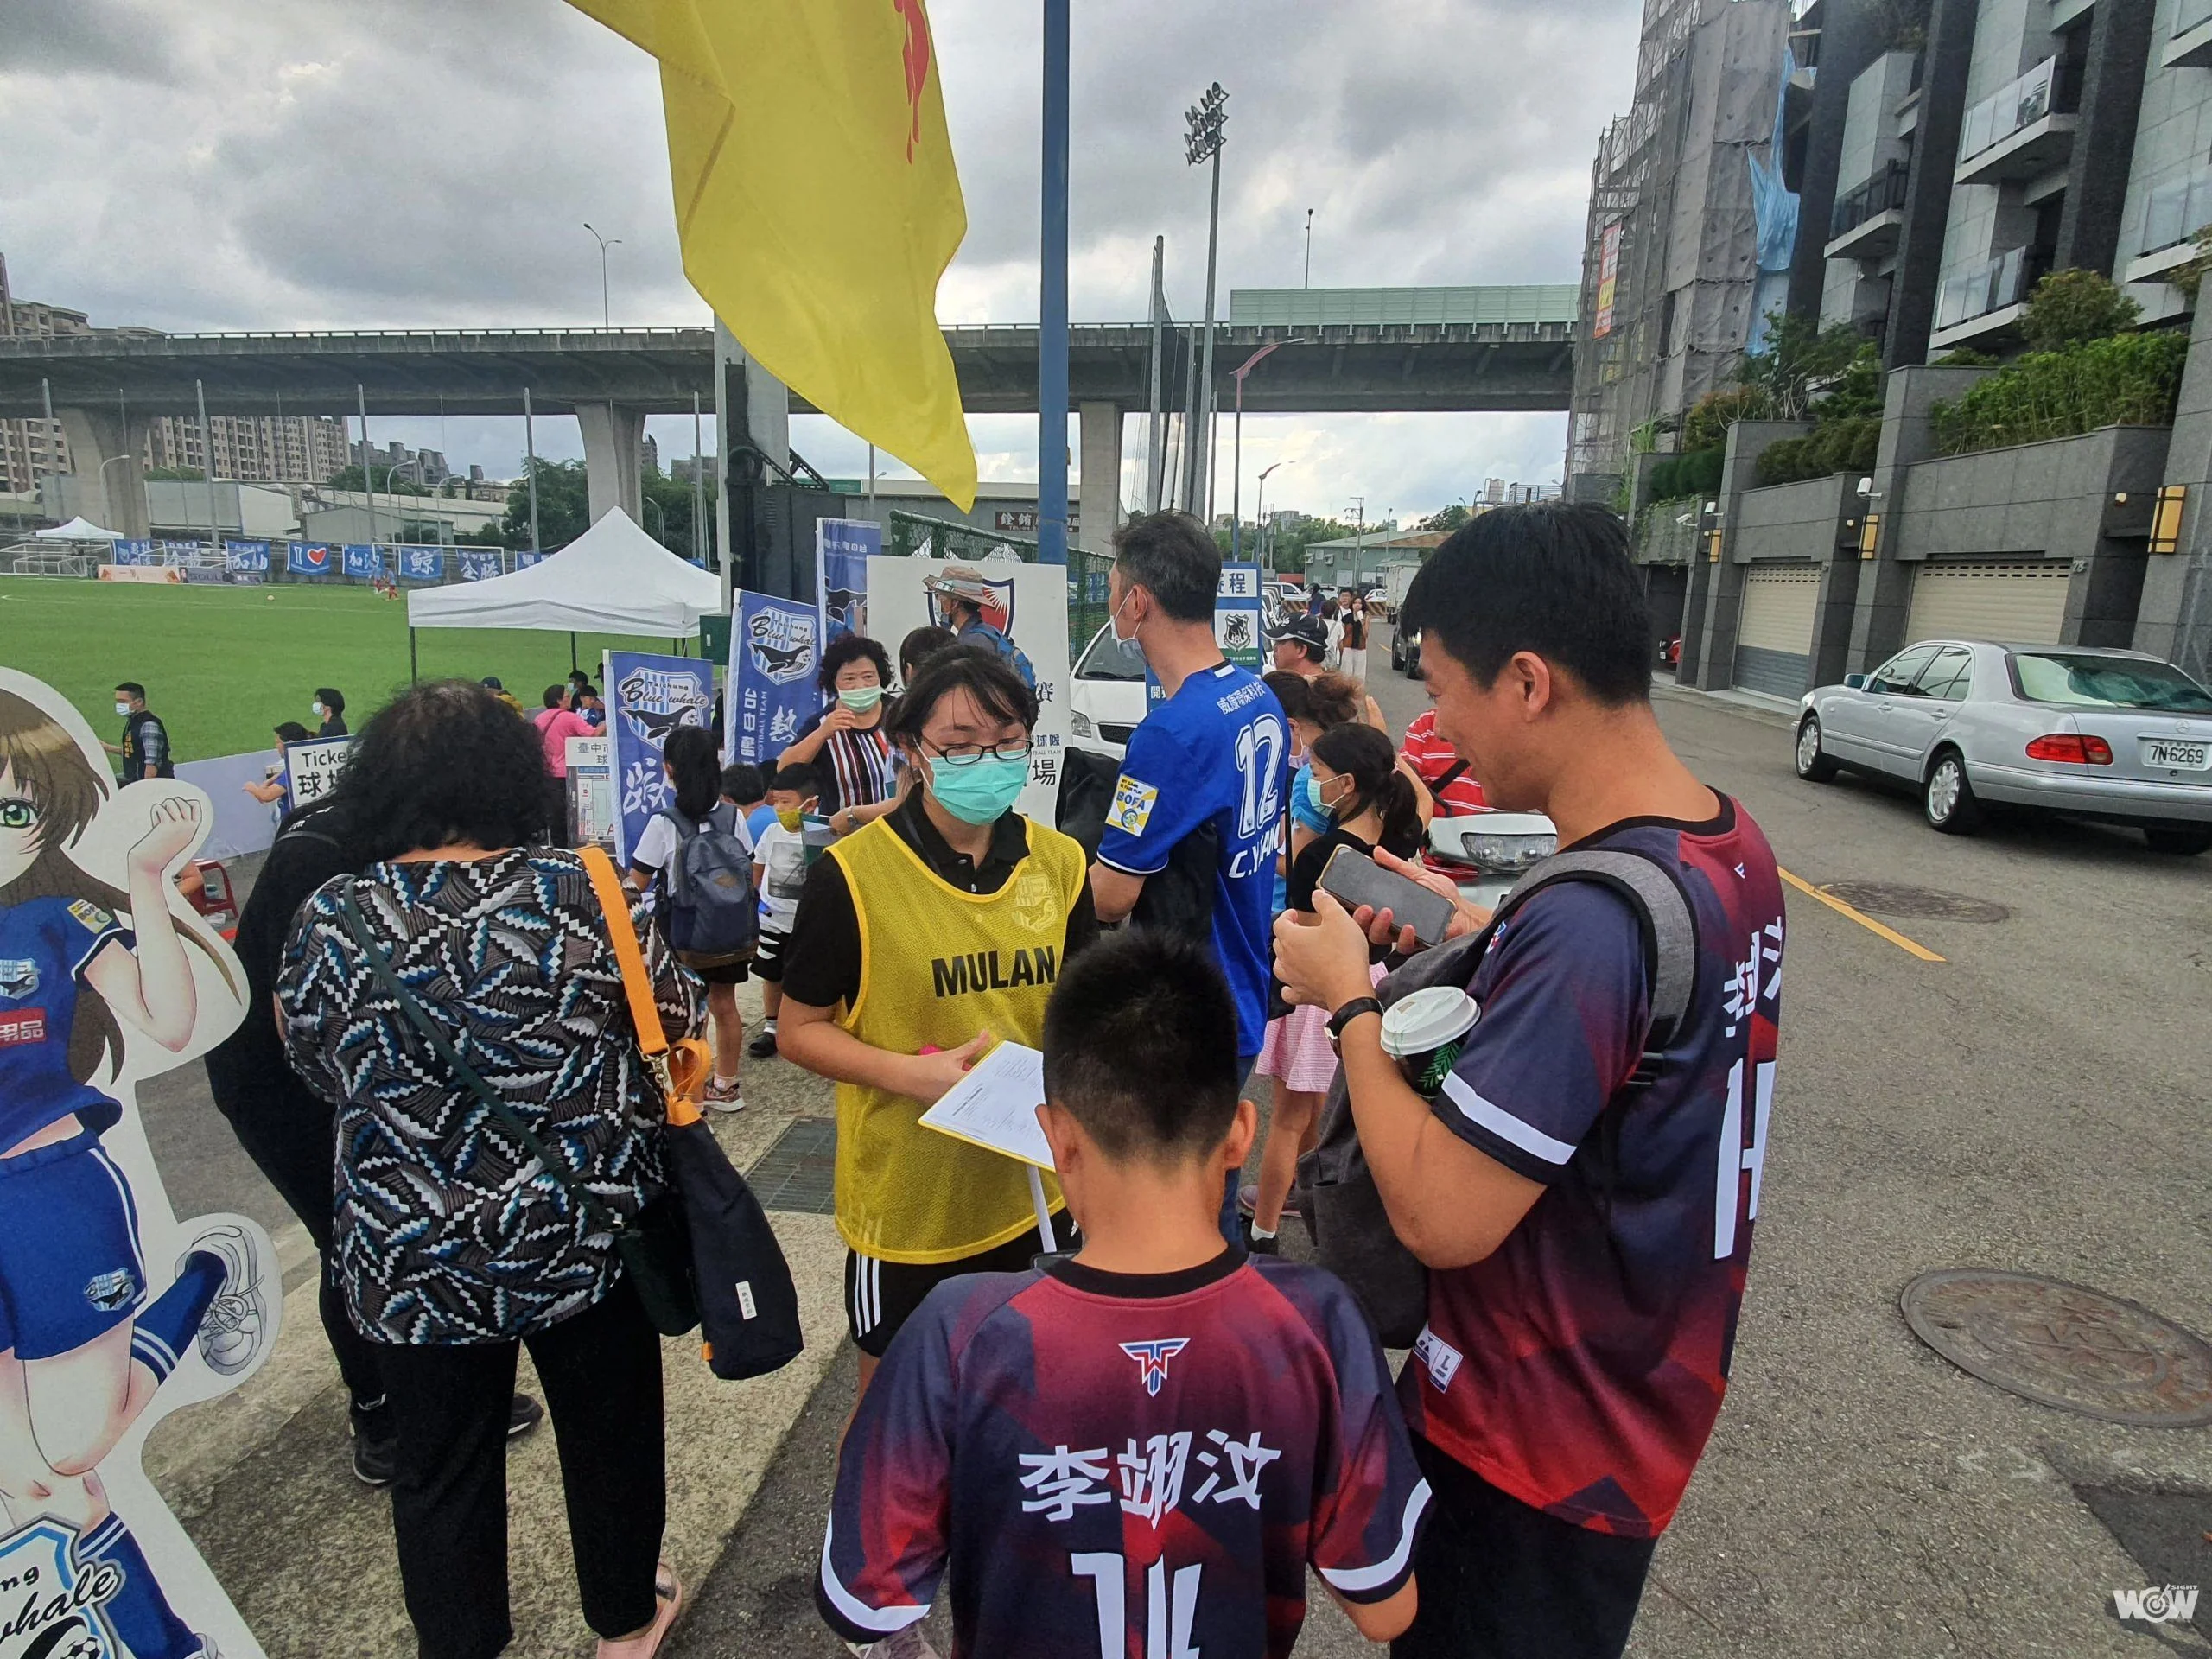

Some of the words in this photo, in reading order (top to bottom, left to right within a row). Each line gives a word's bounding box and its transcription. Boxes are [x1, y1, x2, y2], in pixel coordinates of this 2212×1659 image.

[751, 615, 785, 640] Blue
[789, 634, 817, 645] whal
[621, 677, 664, 703] Blue
[668, 693, 707, 705] whale
[302, 749, 346, 767] Ticke
[2151, 745, 2204, 764] 7N-6269
[1235, 713, 1283, 840] 12
[1116, 791, 1146, 810] BOFA
[931, 945, 1055, 997] MULAN
[1018, 1428, 1282, 1531] 李翊汶
